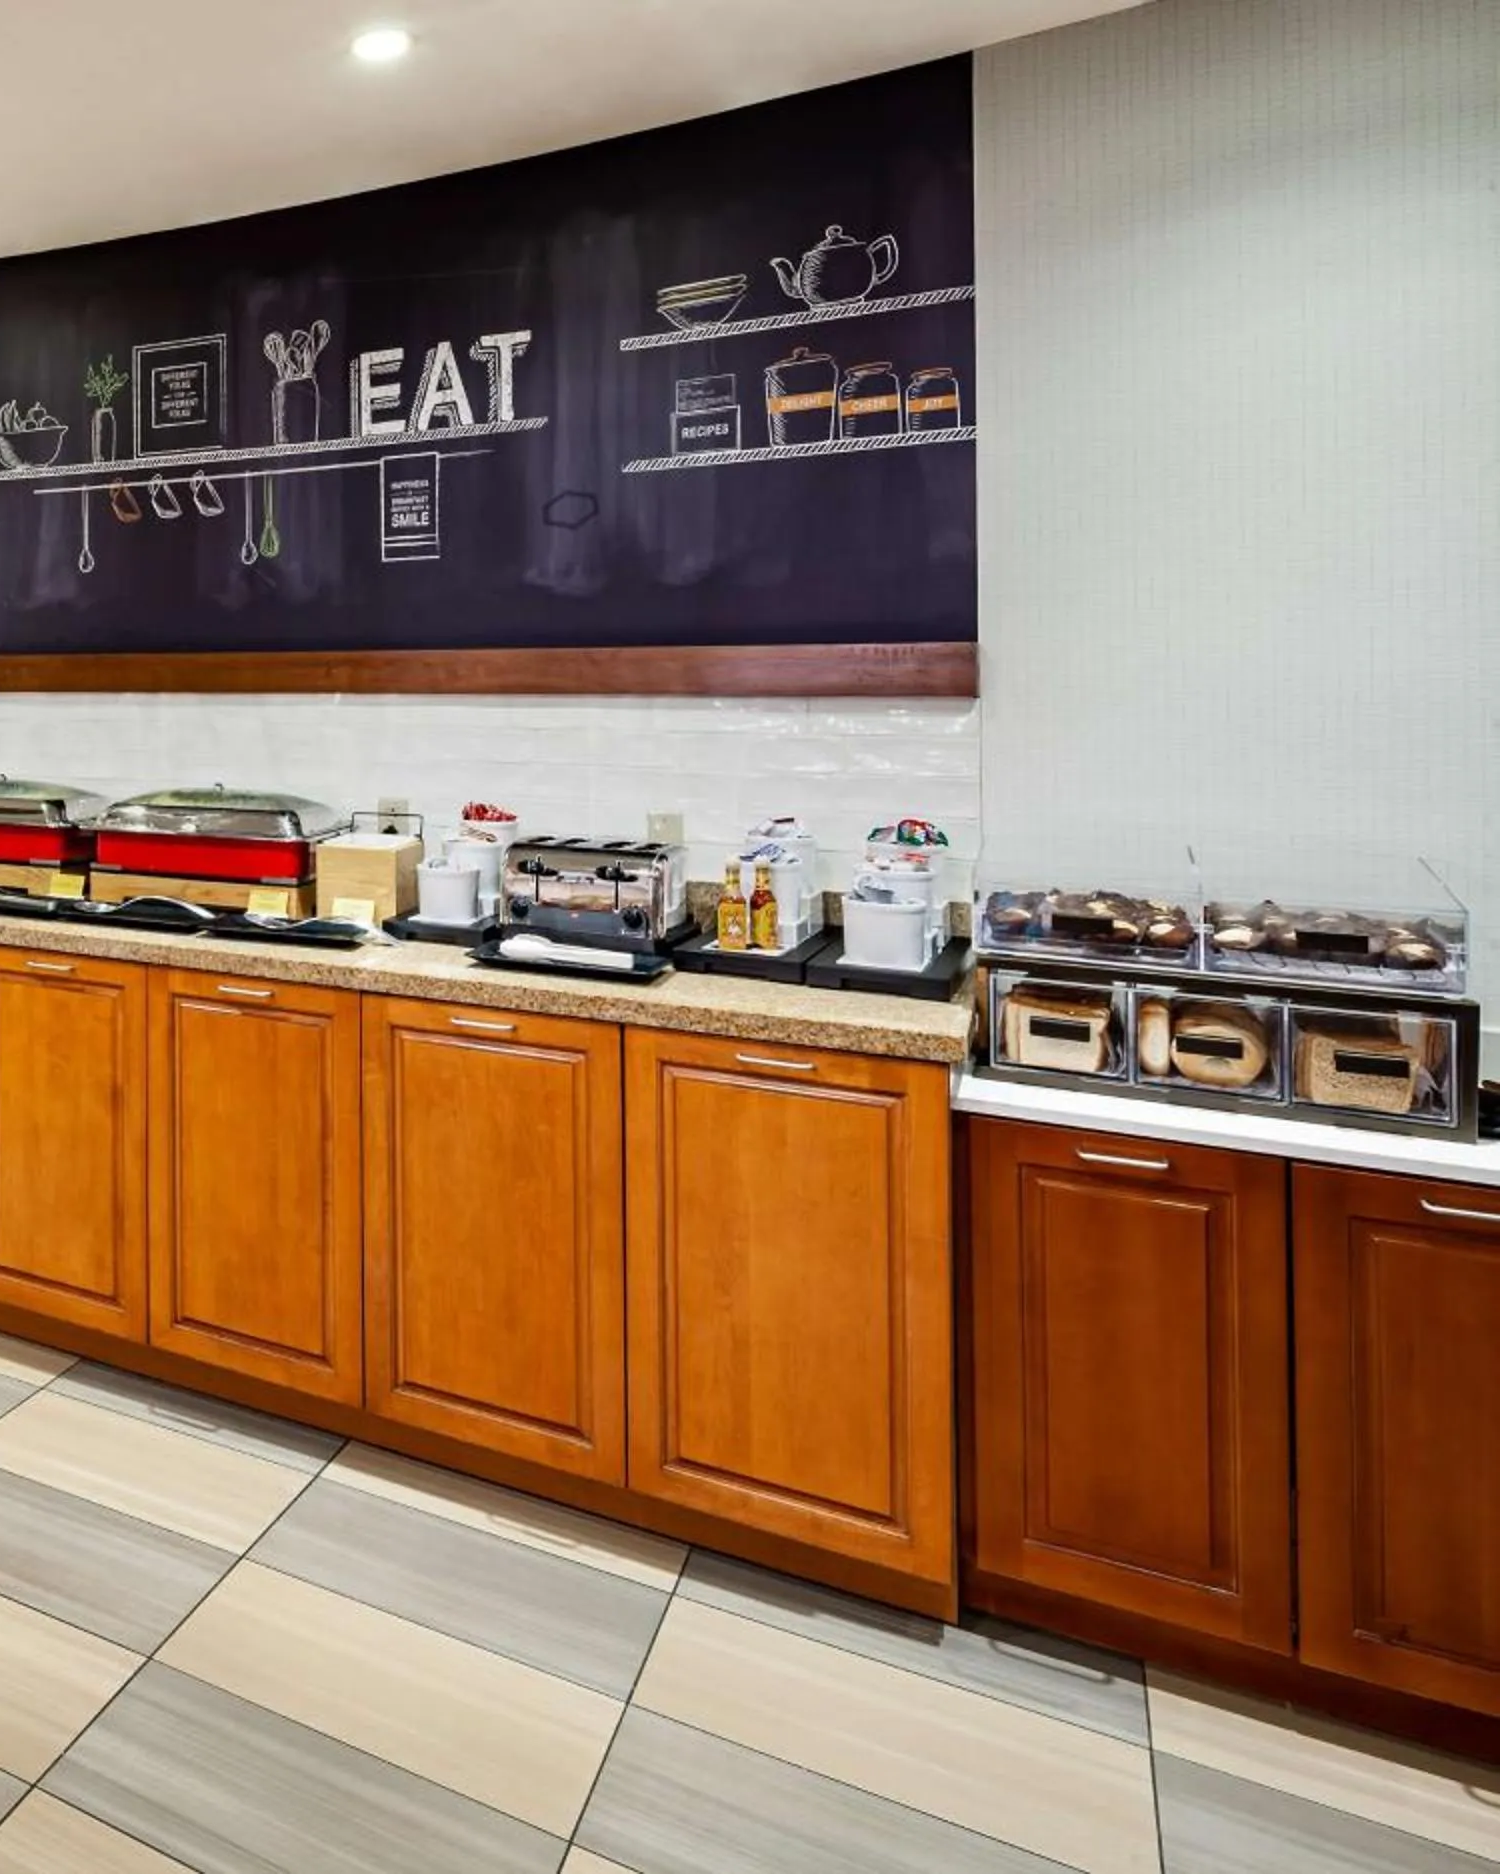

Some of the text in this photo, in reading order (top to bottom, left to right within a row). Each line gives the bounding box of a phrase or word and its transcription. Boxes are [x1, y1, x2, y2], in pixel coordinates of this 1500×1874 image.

[350, 330, 532, 437] EAT
[681, 423, 729, 439] RECIPES
[391, 511, 430, 528] SMILE
